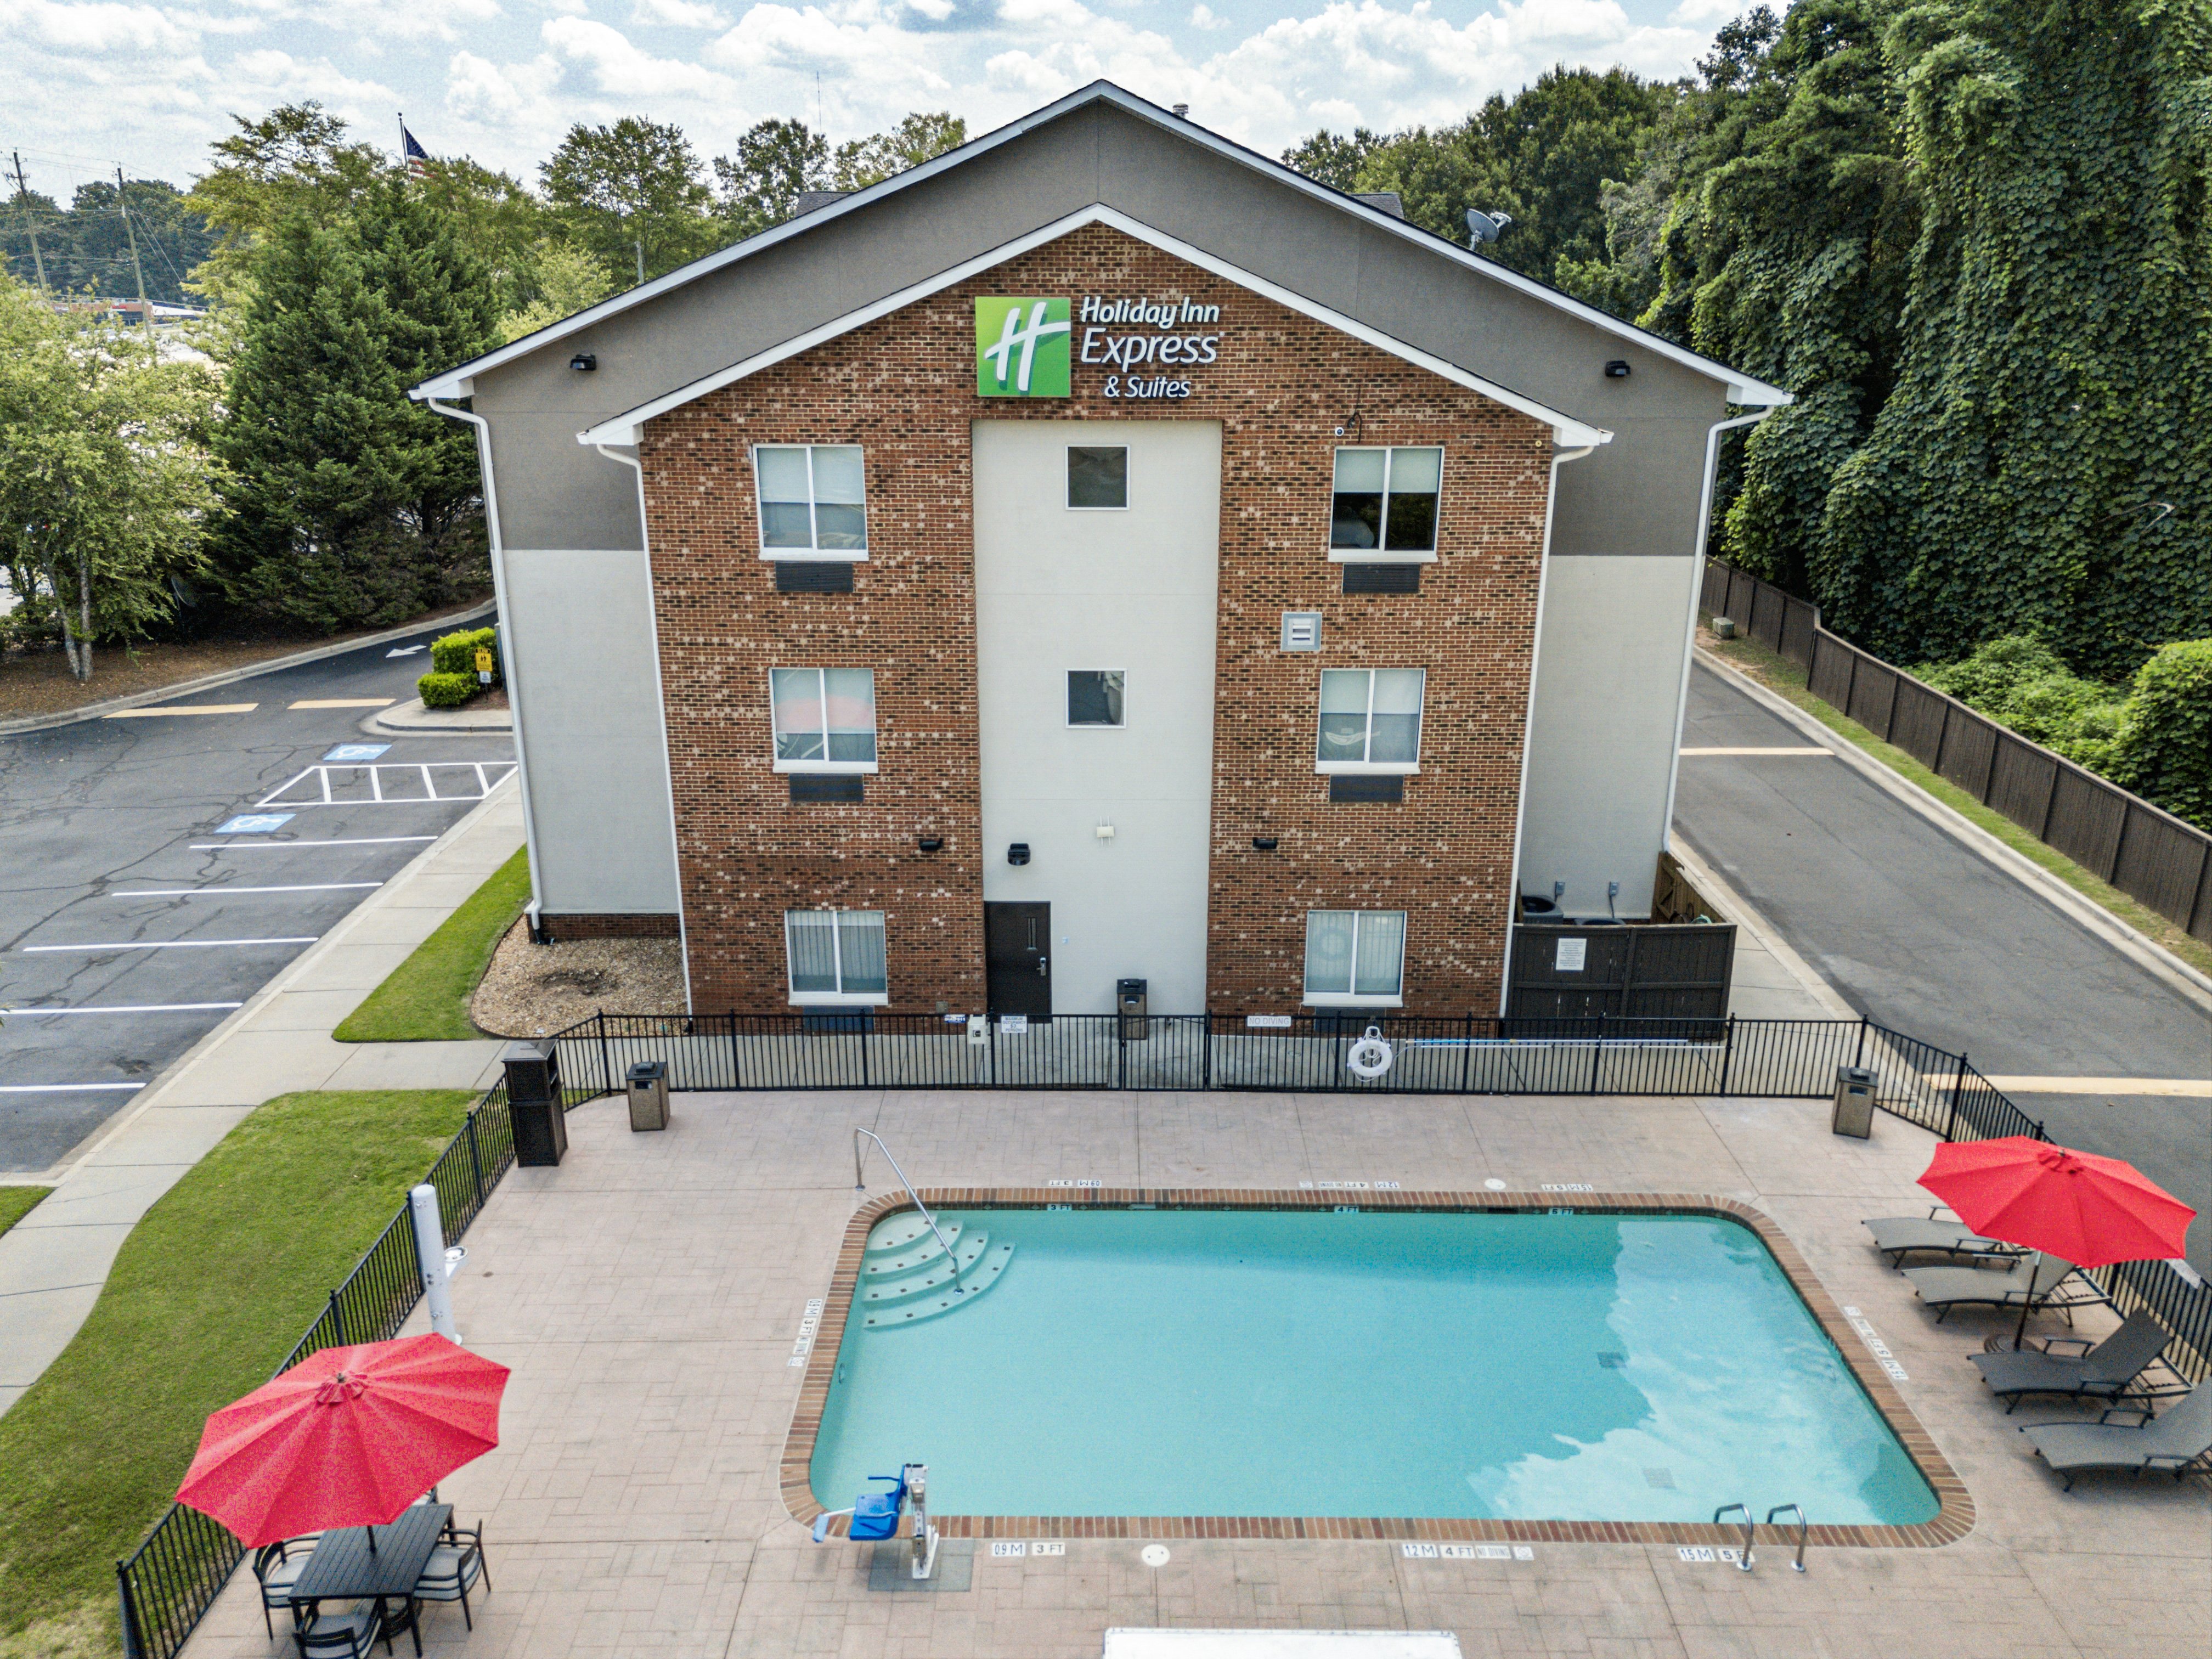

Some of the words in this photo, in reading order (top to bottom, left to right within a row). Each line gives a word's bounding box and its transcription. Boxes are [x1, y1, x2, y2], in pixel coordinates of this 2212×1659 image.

[1080, 296, 1177, 329] Holiday
[1181, 297, 1220, 323] Inn
[1104, 376, 1120, 397] &
[1125, 376, 1190, 398] Suites
[1011, 1544, 1023, 1555] M
[1036, 1544, 1044, 1553] 3
[1050, 1544, 1063, 1553] FT
[1421, 1545, 1435, 1556] M
[1446, 1547, 1453, 1556] 4
[1459, 1547, 1472, 1556] FT
[1697, 1549, 1712, 1560] M
[1723, 1550, 1733, 1559] 5
